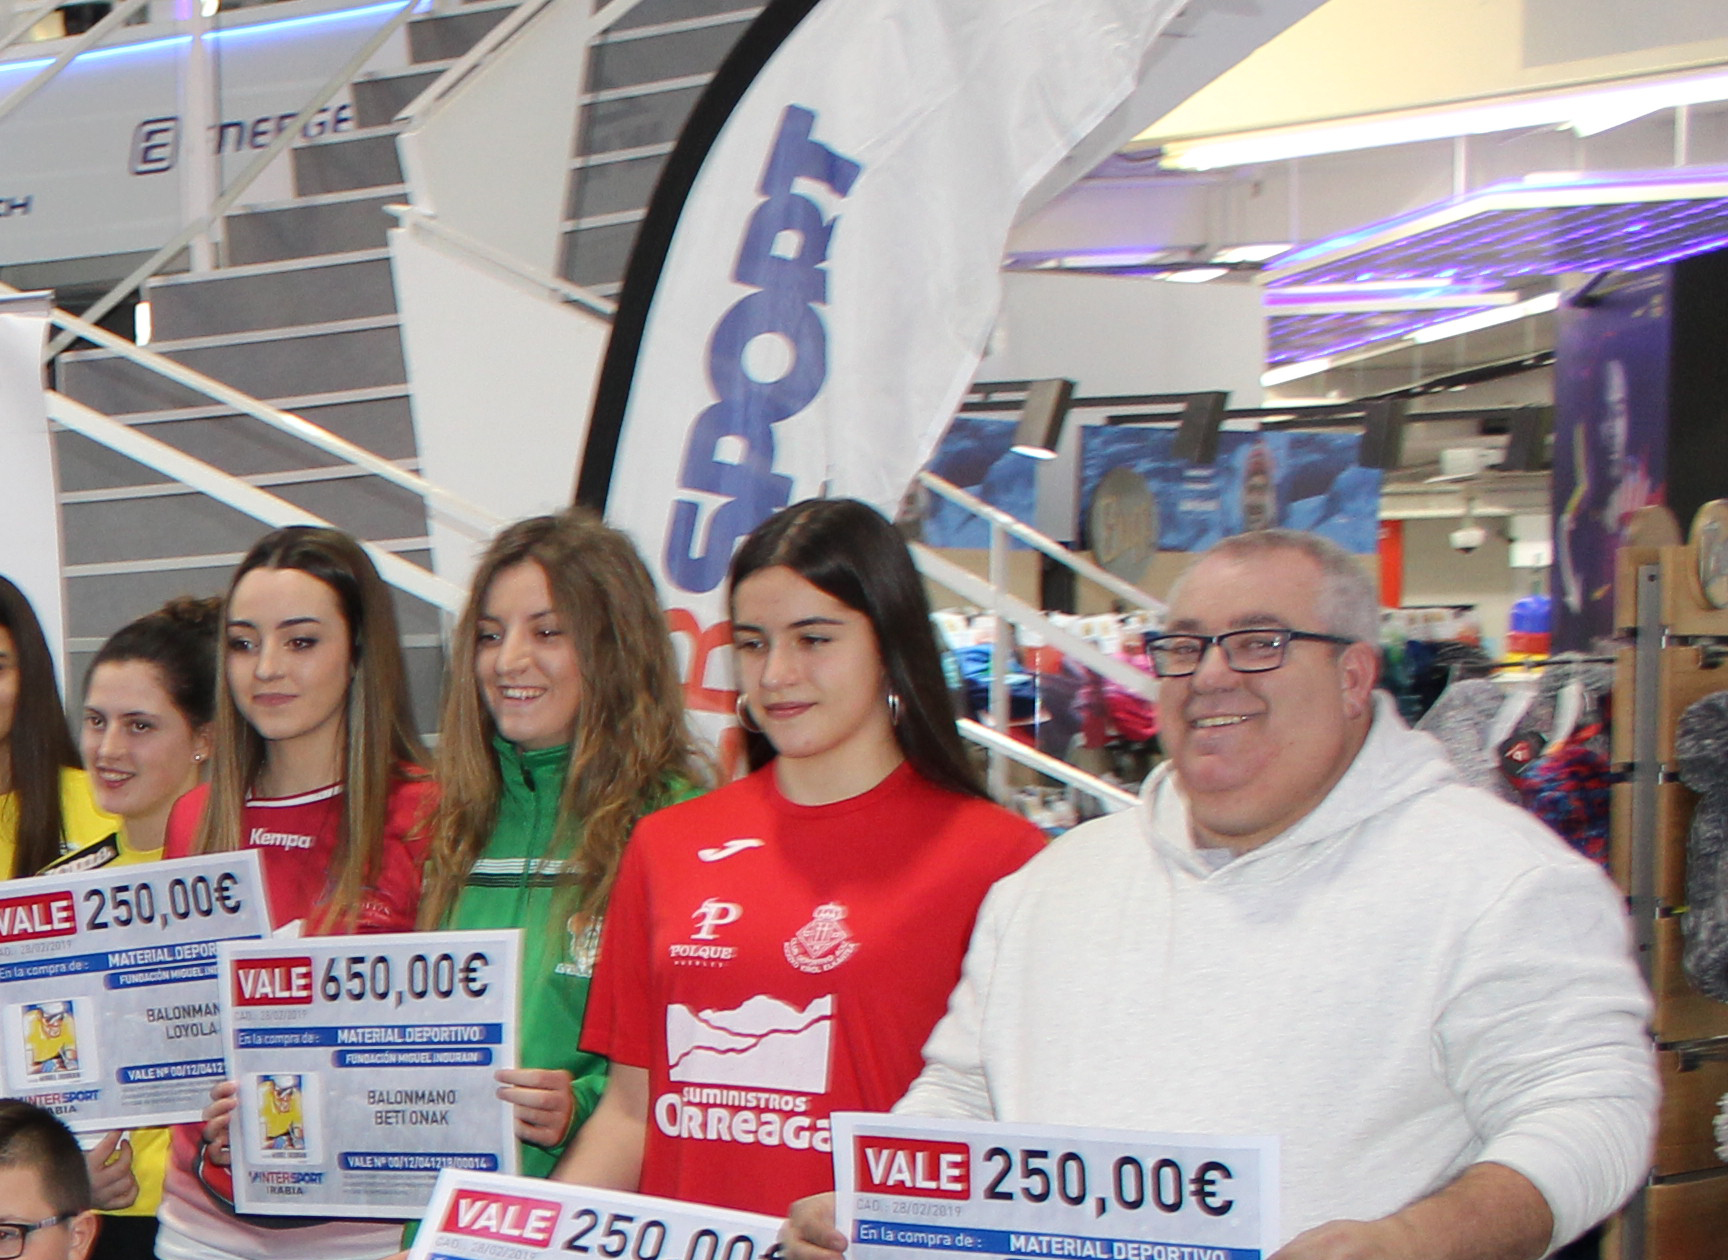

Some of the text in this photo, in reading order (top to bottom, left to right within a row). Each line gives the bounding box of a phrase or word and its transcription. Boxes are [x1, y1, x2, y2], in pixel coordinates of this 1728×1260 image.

[249, 827, 311, 850] Kempa
[83, 872, 241, 931] 250,00€
[669, 944, 735, 960] POLQUE
[238, 952, 489, 1009] VALE 650,00€
[166, 1024, 218, 1040] LOYOLA
[337, 1026, 481, 1045] MATERIAL DEPORTIVO
[367, 1089, 456, 1105] BALONMANO
[375, 1110, 449, 1126] BETI ONAK
[864, 1146, 1235, 1218] VALE 250,00€
[456, 1198, 555, 1240] VALE
[892, 1201, 962, 1217] 28/02/2019
[859, 1225, 972, 1248] En la compra de
[1010, 1235, 1110, 1260] MATERIAL
